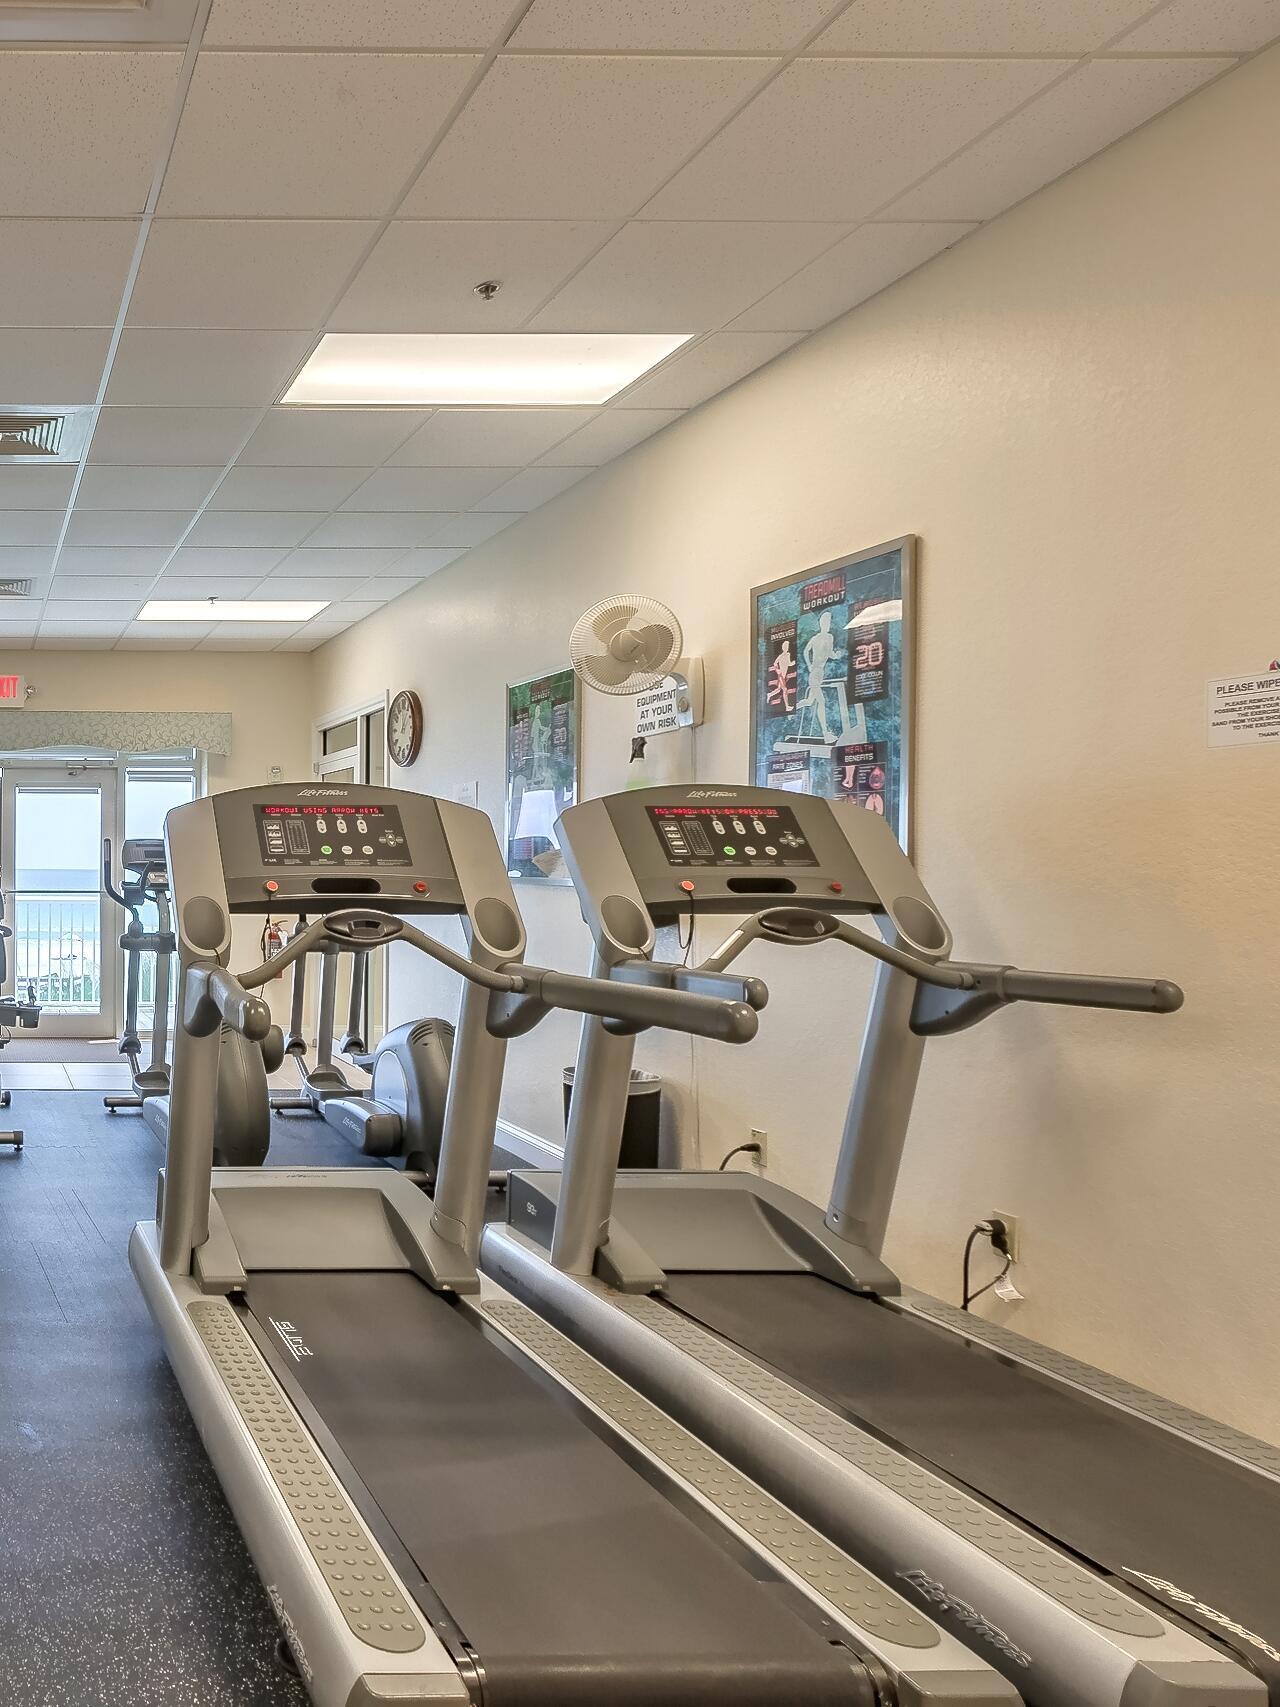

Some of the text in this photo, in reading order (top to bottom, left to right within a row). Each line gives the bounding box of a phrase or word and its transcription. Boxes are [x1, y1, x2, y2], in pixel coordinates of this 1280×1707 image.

[803, 591, 846, 611] WORKOUT
[852, 641, 885, 670] 20
[1216, 682, 1254, 695] PLEASE
[636, 689, 677, 708] EQUIPMENT
[640, 704, 673, 720] AT YOUR
[637, 716, 677, 733] OWN RISK
